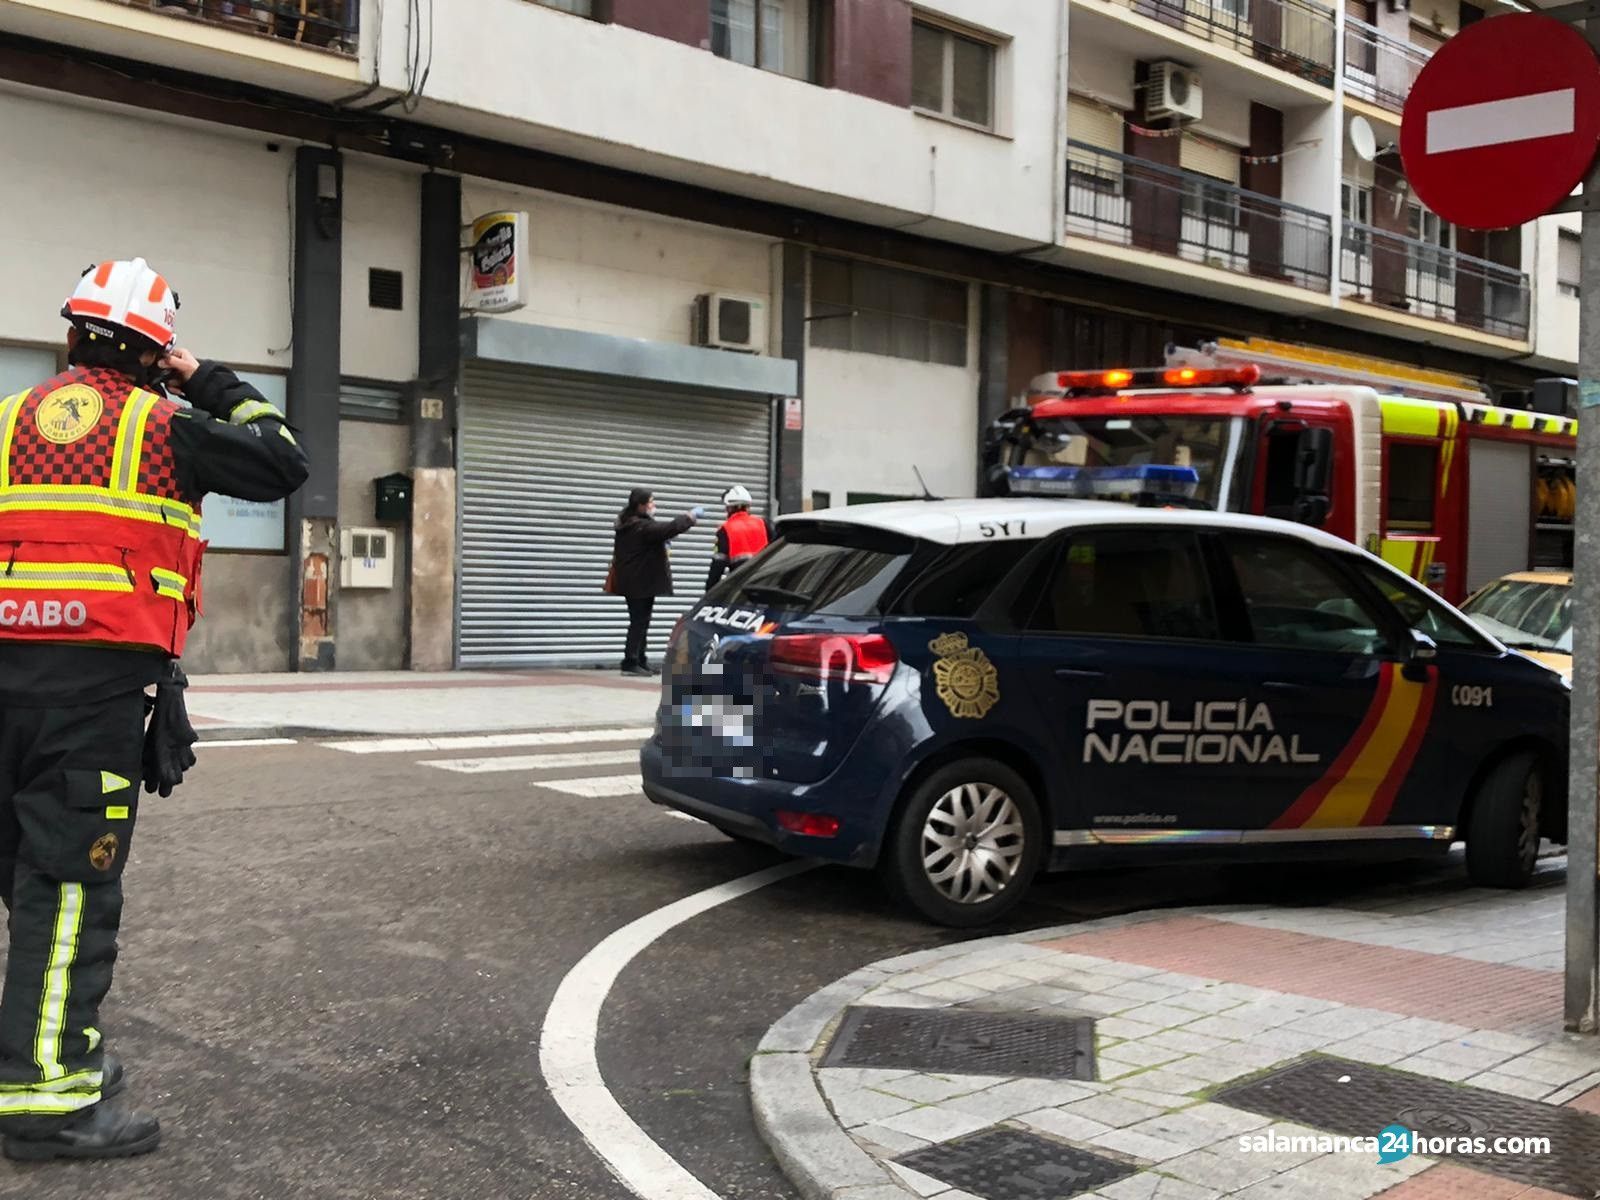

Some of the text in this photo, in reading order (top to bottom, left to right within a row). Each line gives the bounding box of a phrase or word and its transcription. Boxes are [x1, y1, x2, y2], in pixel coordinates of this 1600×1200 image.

[0, 599, 87, 627] CABO
[1086, 698, 1275, 731] POLICÍA
[1082, 733, 1320, 764] NACIONAL
